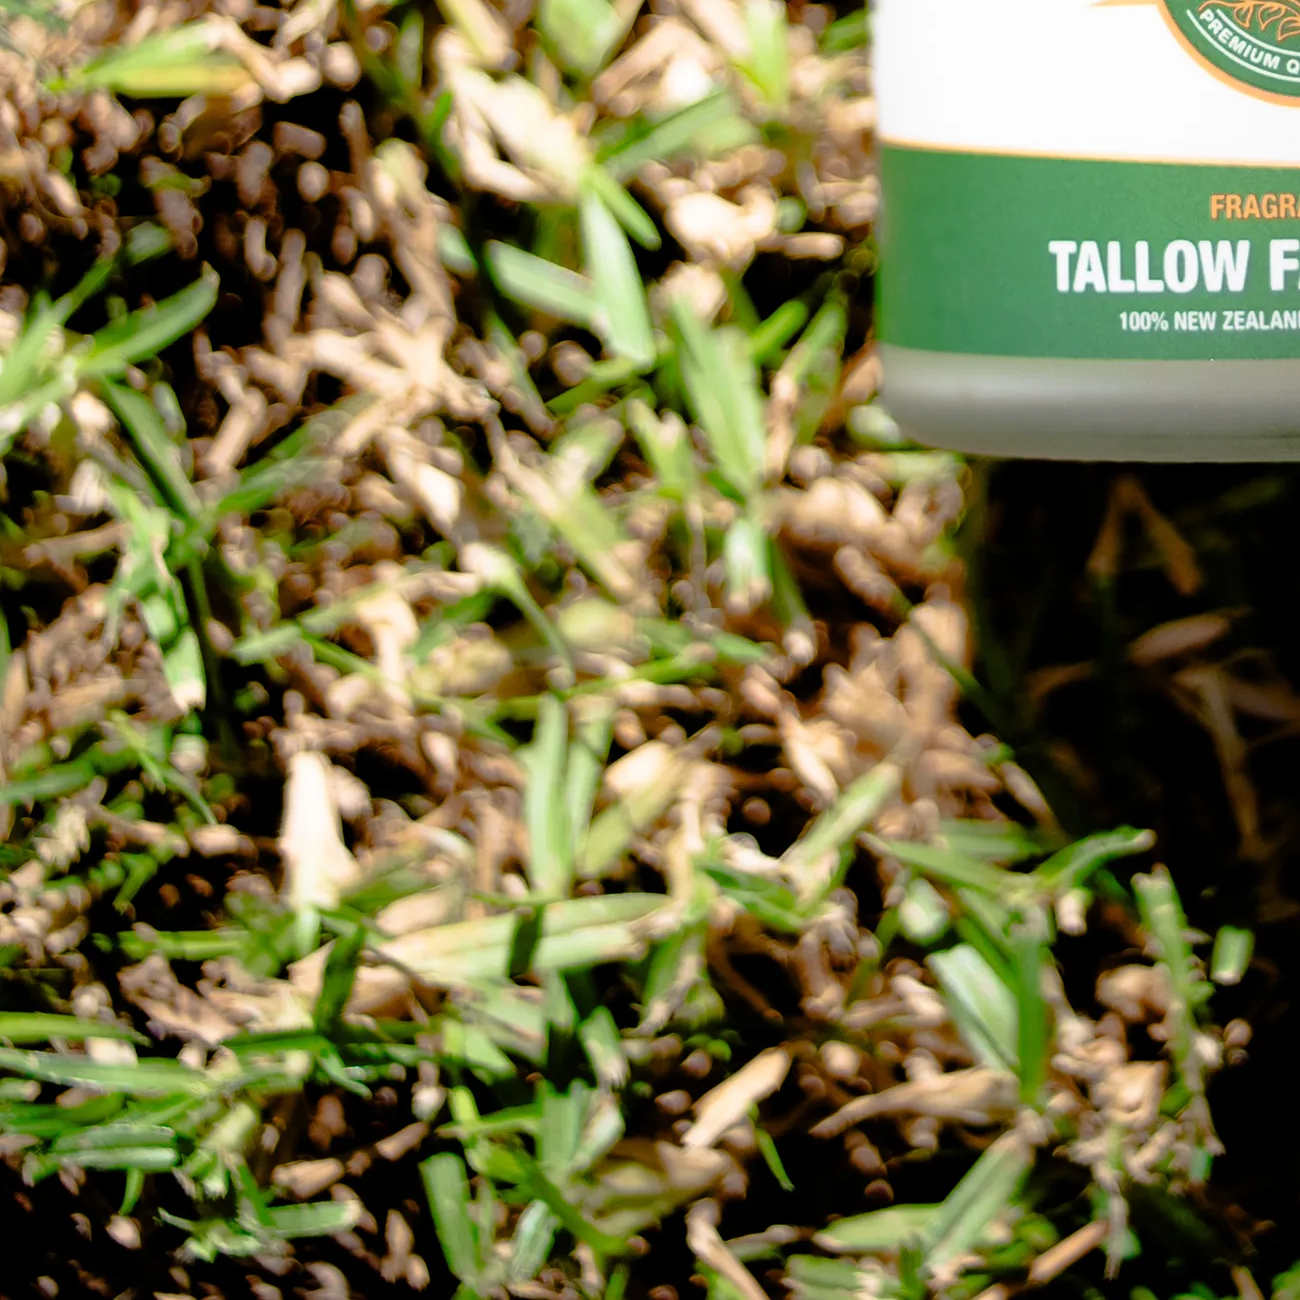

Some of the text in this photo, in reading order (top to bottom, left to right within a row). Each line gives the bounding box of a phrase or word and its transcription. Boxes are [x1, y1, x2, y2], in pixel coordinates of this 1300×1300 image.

[1199, 8, 1281, 70] PREMIUM
[1048, 239, 1250, 293] TALLOW
[1120, 310, 1169, 331] 100%
[1174, 310, 1217, 331] NEW
